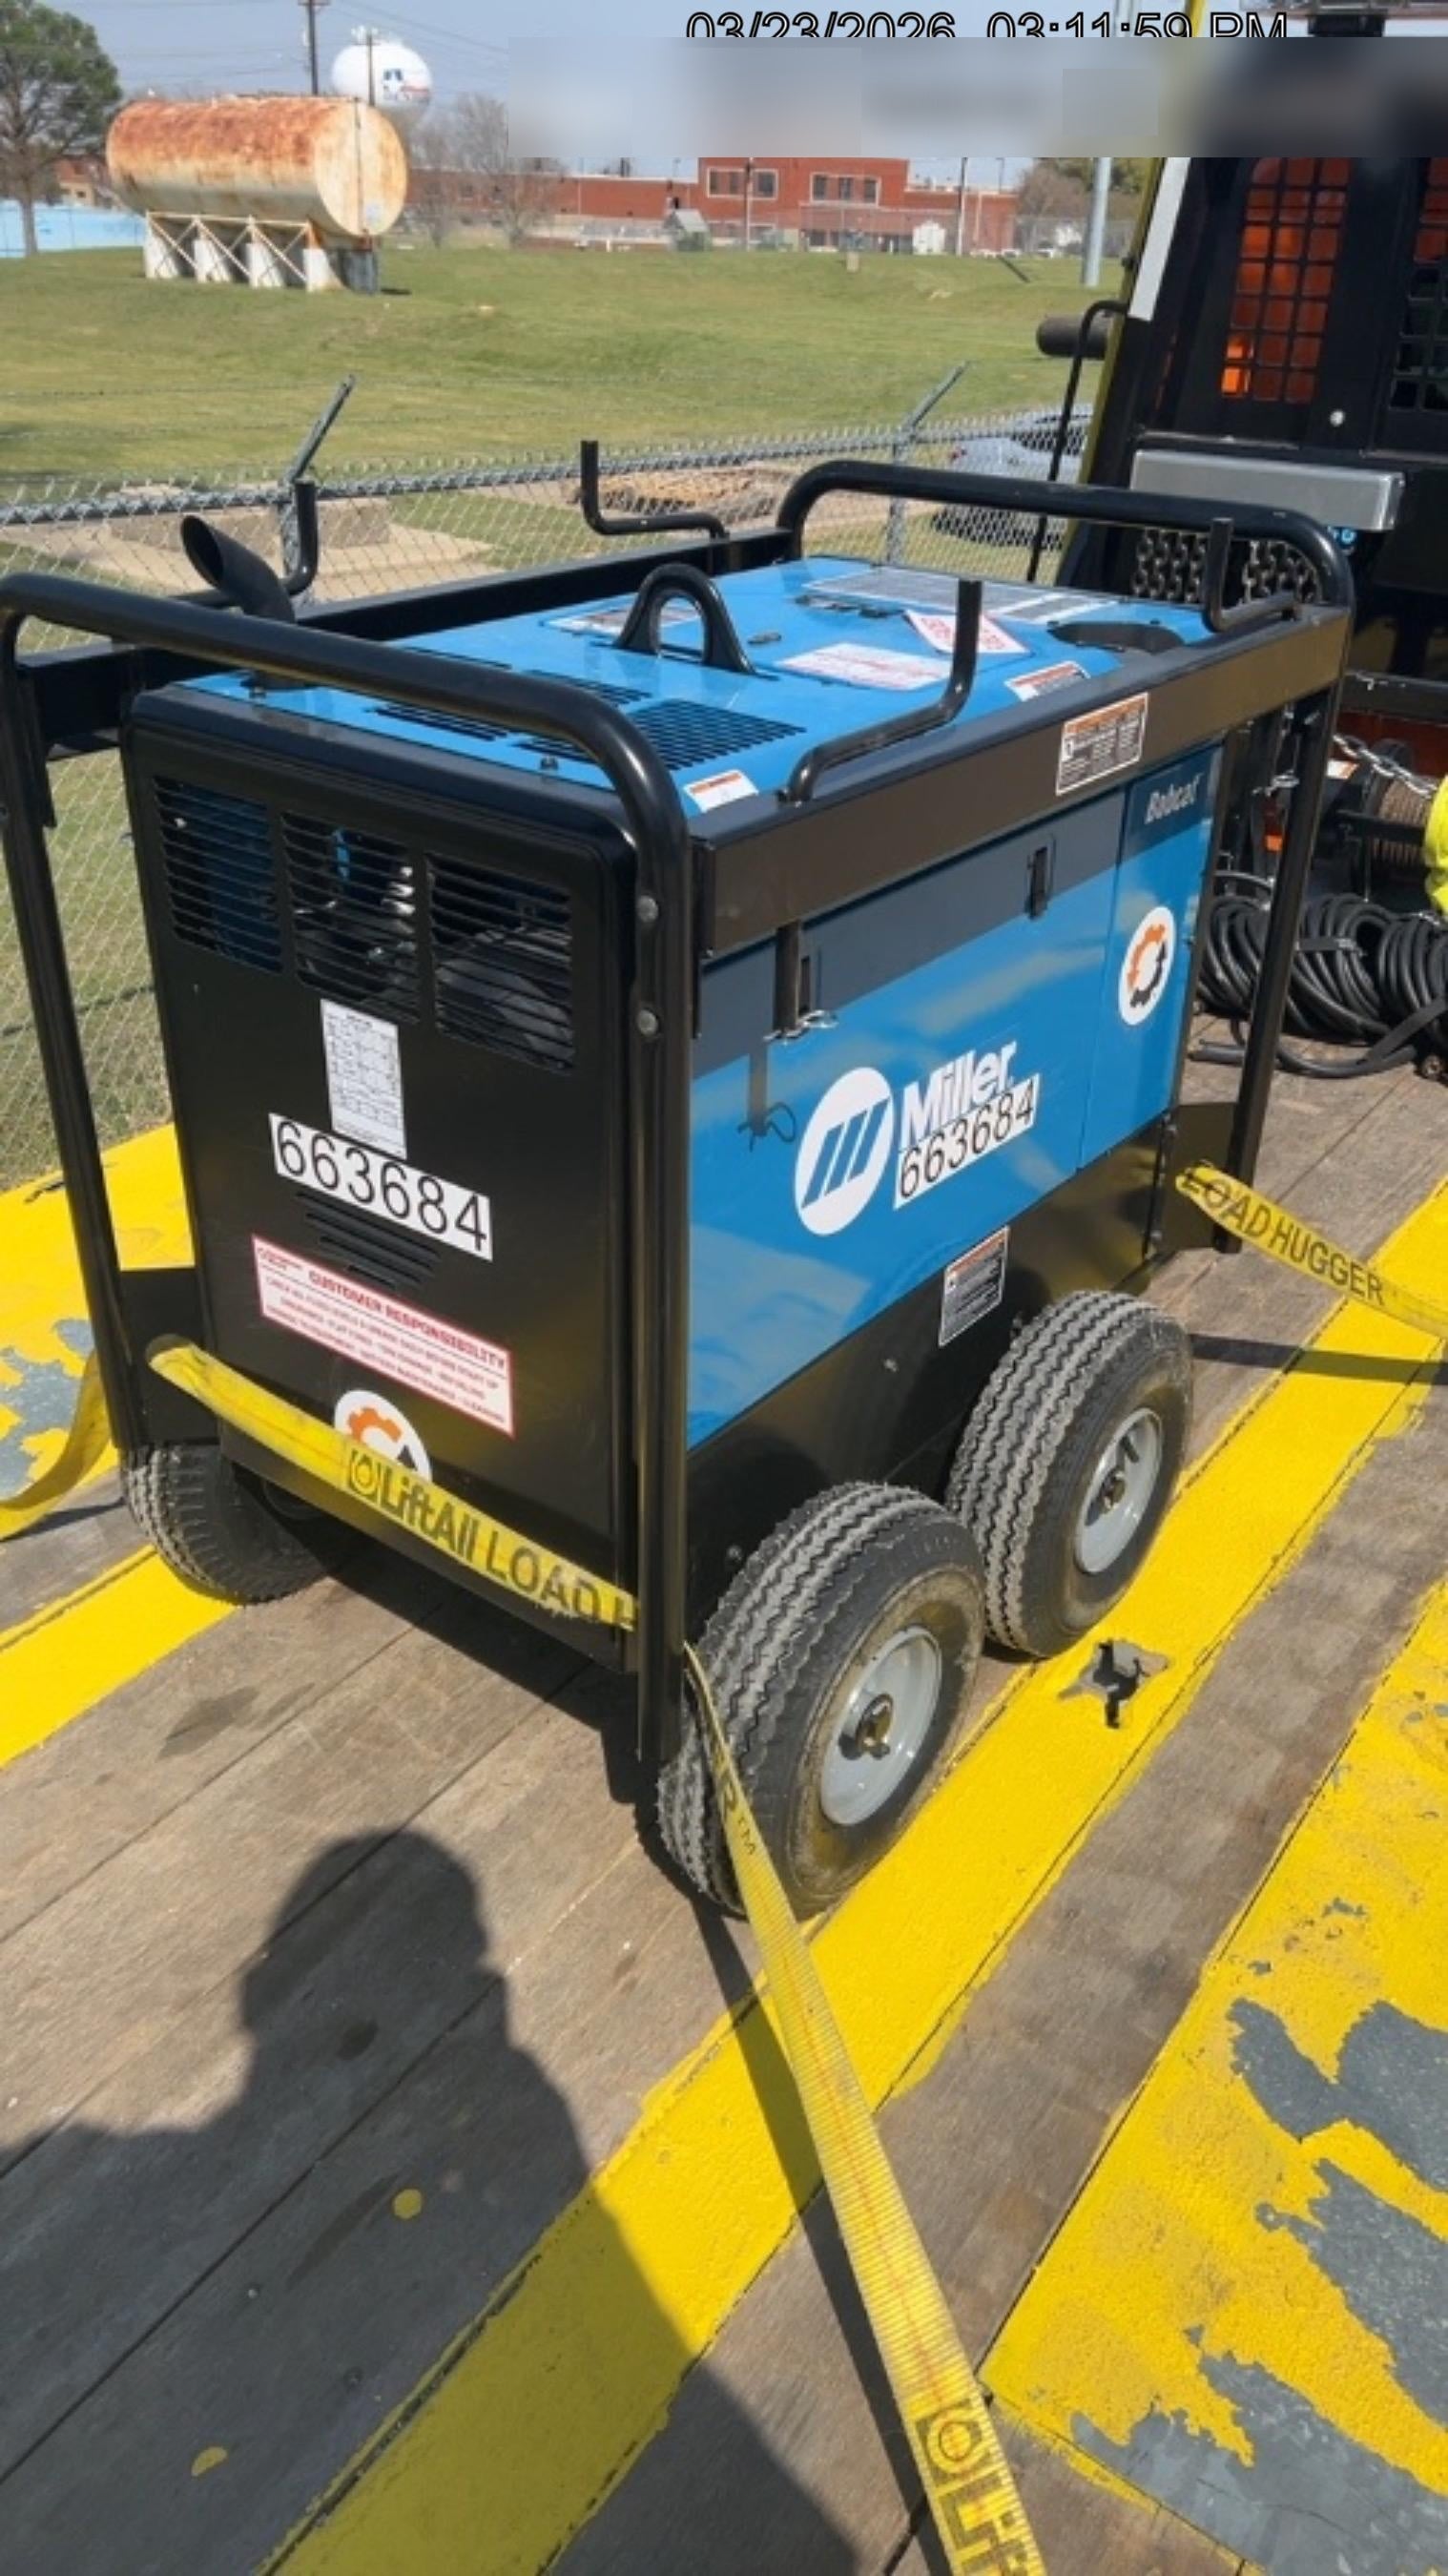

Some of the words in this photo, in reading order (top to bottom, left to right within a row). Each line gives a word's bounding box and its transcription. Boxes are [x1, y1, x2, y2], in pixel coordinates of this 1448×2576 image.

[900, 1040, 1017, 1147] Miller
[900, 1079, 1034, 1198] 663684
[278, 1121, 486, 1251] 663684
[1182, 1171, 1272, 1237] LOAD
[1270, 1221, 1383, 1305] HUGGER
[309, 1270, 382, 1312] CUSTOMER
[386, 1304, 505, 1368] RESPONSIBILITY
[486, 1531, 601, 1621] LOAD
